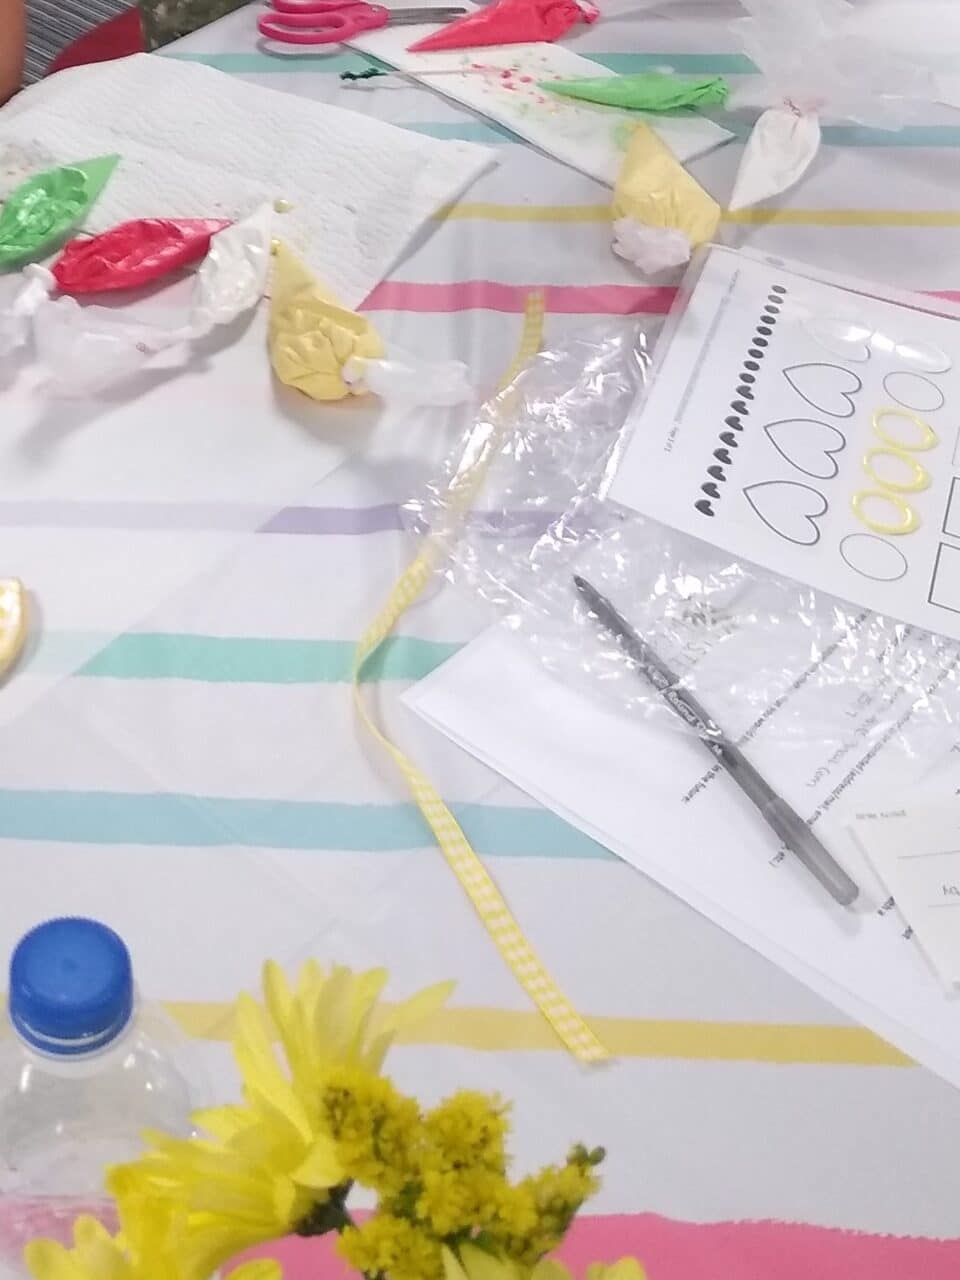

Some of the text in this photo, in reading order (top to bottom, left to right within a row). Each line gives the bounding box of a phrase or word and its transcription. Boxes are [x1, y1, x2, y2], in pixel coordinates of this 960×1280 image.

[666, 688, 696, 722] Round
[745, 716, 765, 739] would
[701, 769, 716, 785] the
